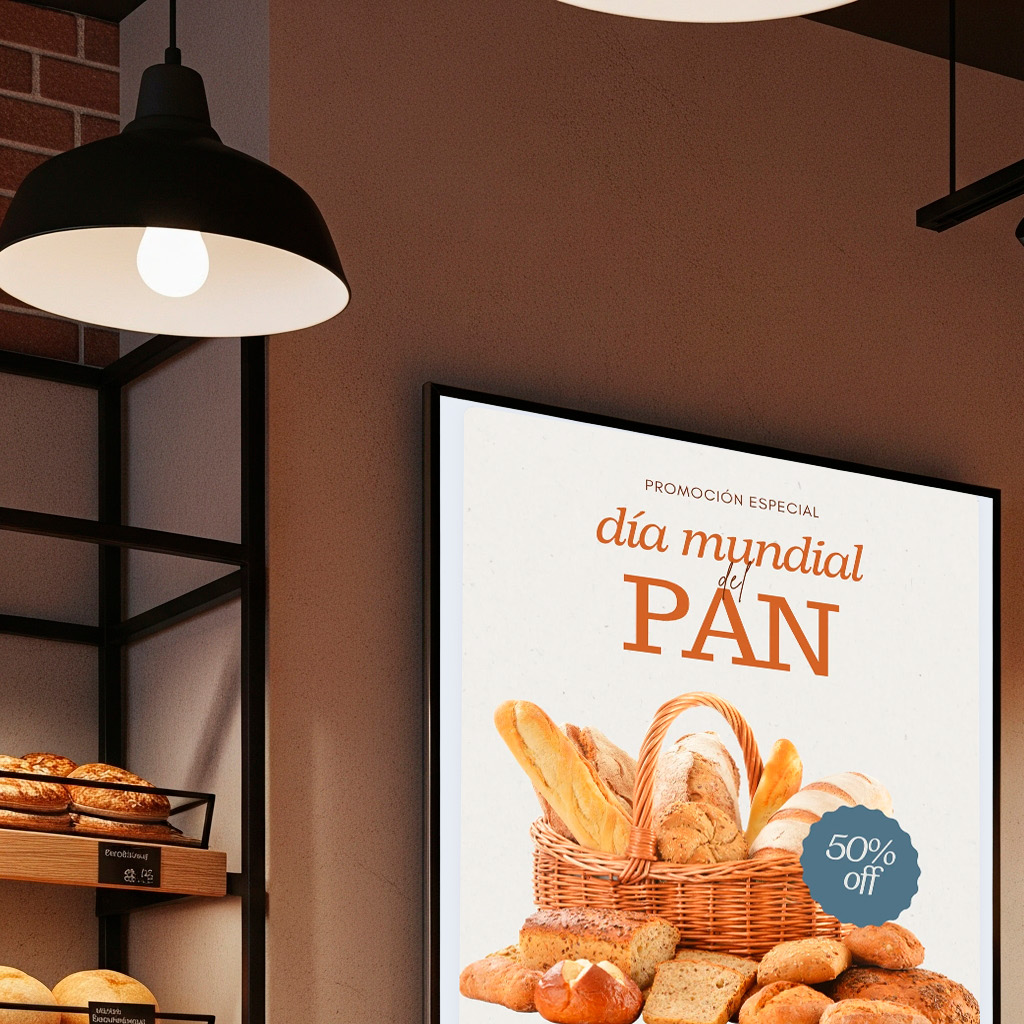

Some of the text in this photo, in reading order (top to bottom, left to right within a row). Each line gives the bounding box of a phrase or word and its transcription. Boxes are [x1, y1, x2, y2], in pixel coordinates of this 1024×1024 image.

[645, 479, 819, 518] PROMOCIÓN ESPECIAL
[597, 507, 863, 582] día mundial
[718, 561, 752, 602] del
[623, 574, 840, 677] PAN
[826, 834, 896, 866] 50%
[844, 865, 885, 896] off
